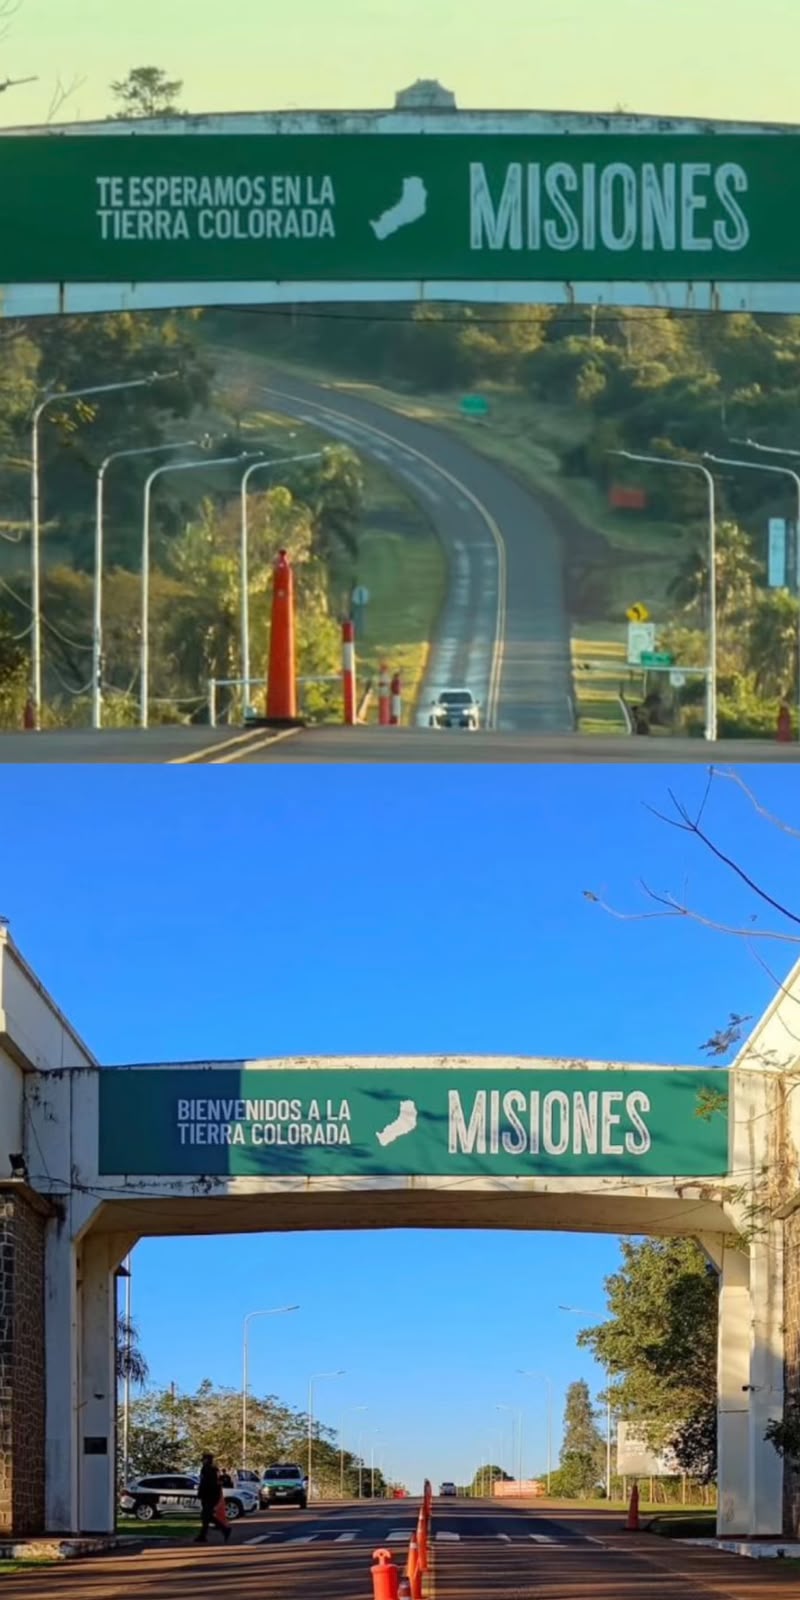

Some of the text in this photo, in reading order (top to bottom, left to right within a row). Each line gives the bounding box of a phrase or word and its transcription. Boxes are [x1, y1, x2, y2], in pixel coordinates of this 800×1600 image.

[96, 175, 336, 207] TE ESPERAMOS EN LA
[469, 161, 750, 251] MISIONES
[96, 208, 336, 240] TIERRA COLORADA
[177, 1099, 351, 1121] BIENVENIDOS A LA
[448, 1089, 651, 1155] MISIONES
[177, 1123, 351, 1145] TIERRA COLORADA
